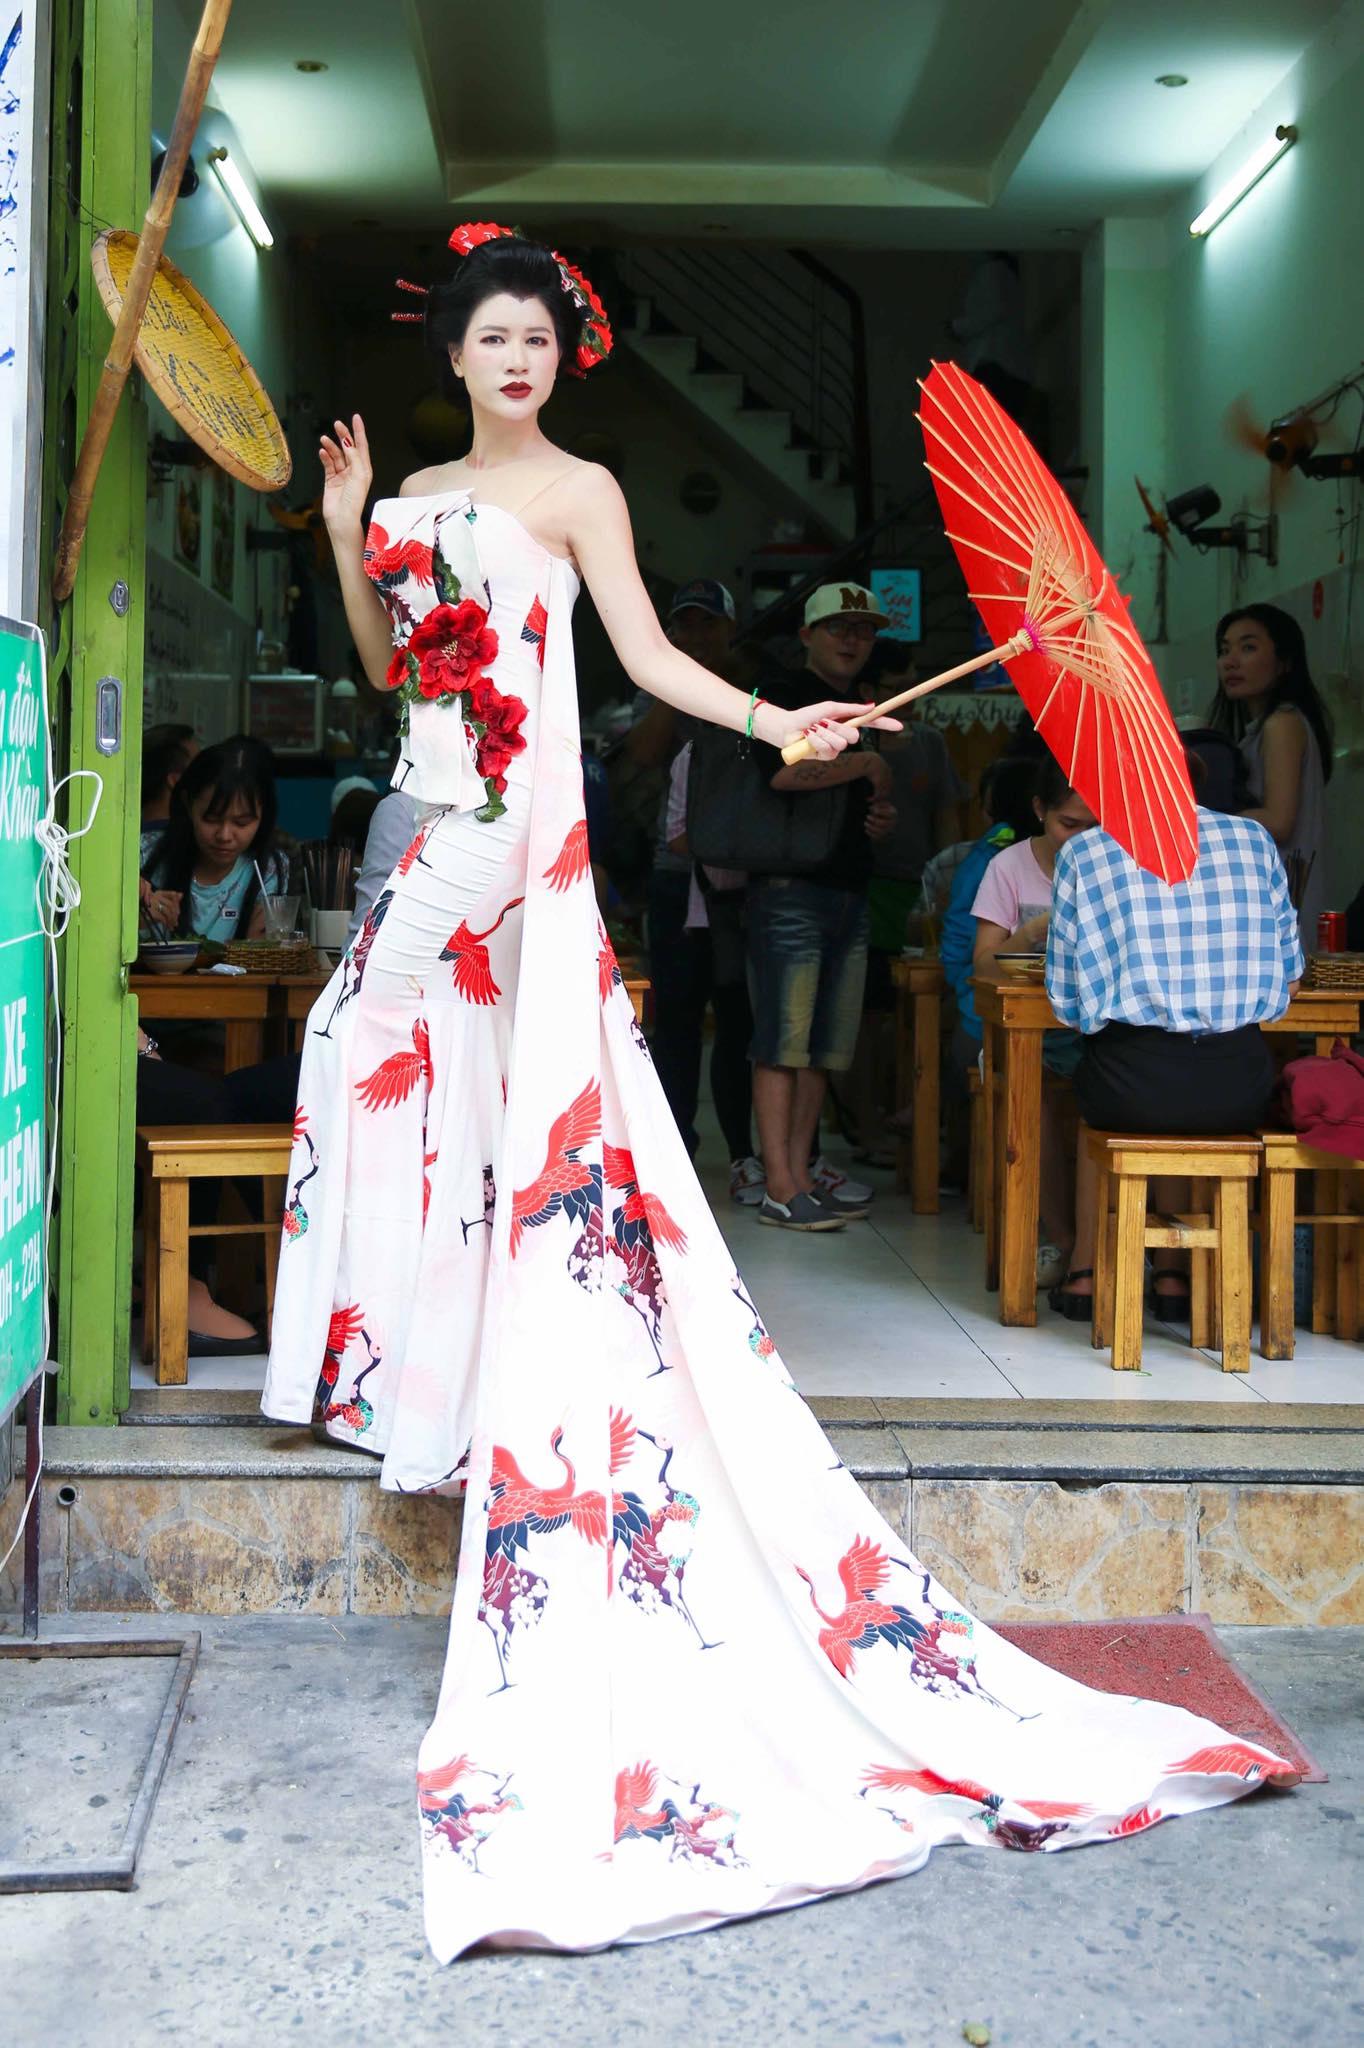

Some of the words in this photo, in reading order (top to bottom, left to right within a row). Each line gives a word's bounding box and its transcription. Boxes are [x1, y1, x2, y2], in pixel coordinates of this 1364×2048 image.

[839, 587, 869, 610] M
[3, 996, 27, 1097] XE
[21, 1230, 41, 1302] 22H
